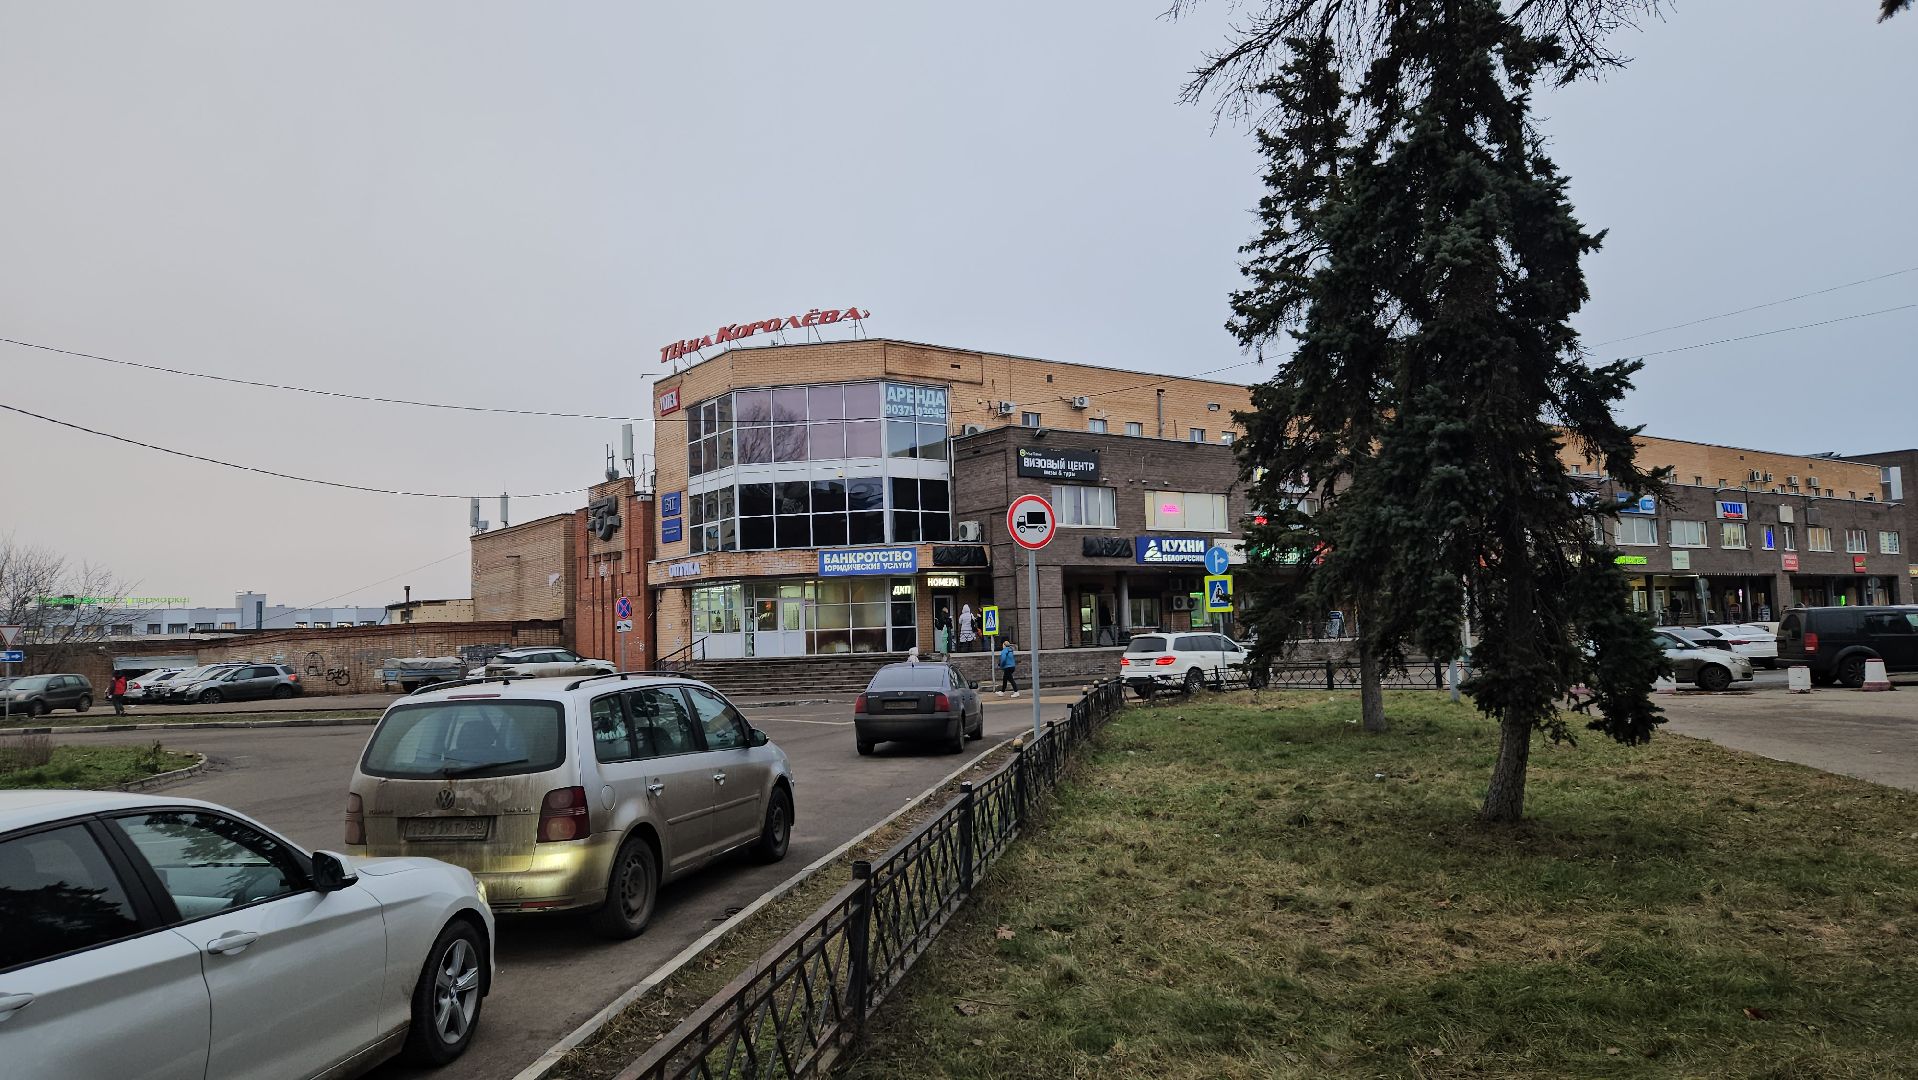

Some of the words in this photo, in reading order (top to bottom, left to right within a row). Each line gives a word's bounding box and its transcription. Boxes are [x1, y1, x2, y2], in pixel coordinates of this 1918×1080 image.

[886, 386, 946, 407] АРЕНДА
[1023, 457, 1066, 470] ВИЗОВЫЙ
[1067, 460, 1095, 471] ЦЕНТР
[1161, 539, 1205, 553] КУХНИ
[823, 550, 913, 565] БАНКРОТСТВО
[1162, 554, 1205, 562] БЕЛОРУССИИ
[668, 561, 701, 577] ОПТИКА
[824, 562, 881, 572] ЮРИДИЧЕСКИЕ
[883, 561, 912, 570] УСЛУГИ
[927, 577, 959, 587] НОМЕРА
[892, 585, 911, 596] ДКП
